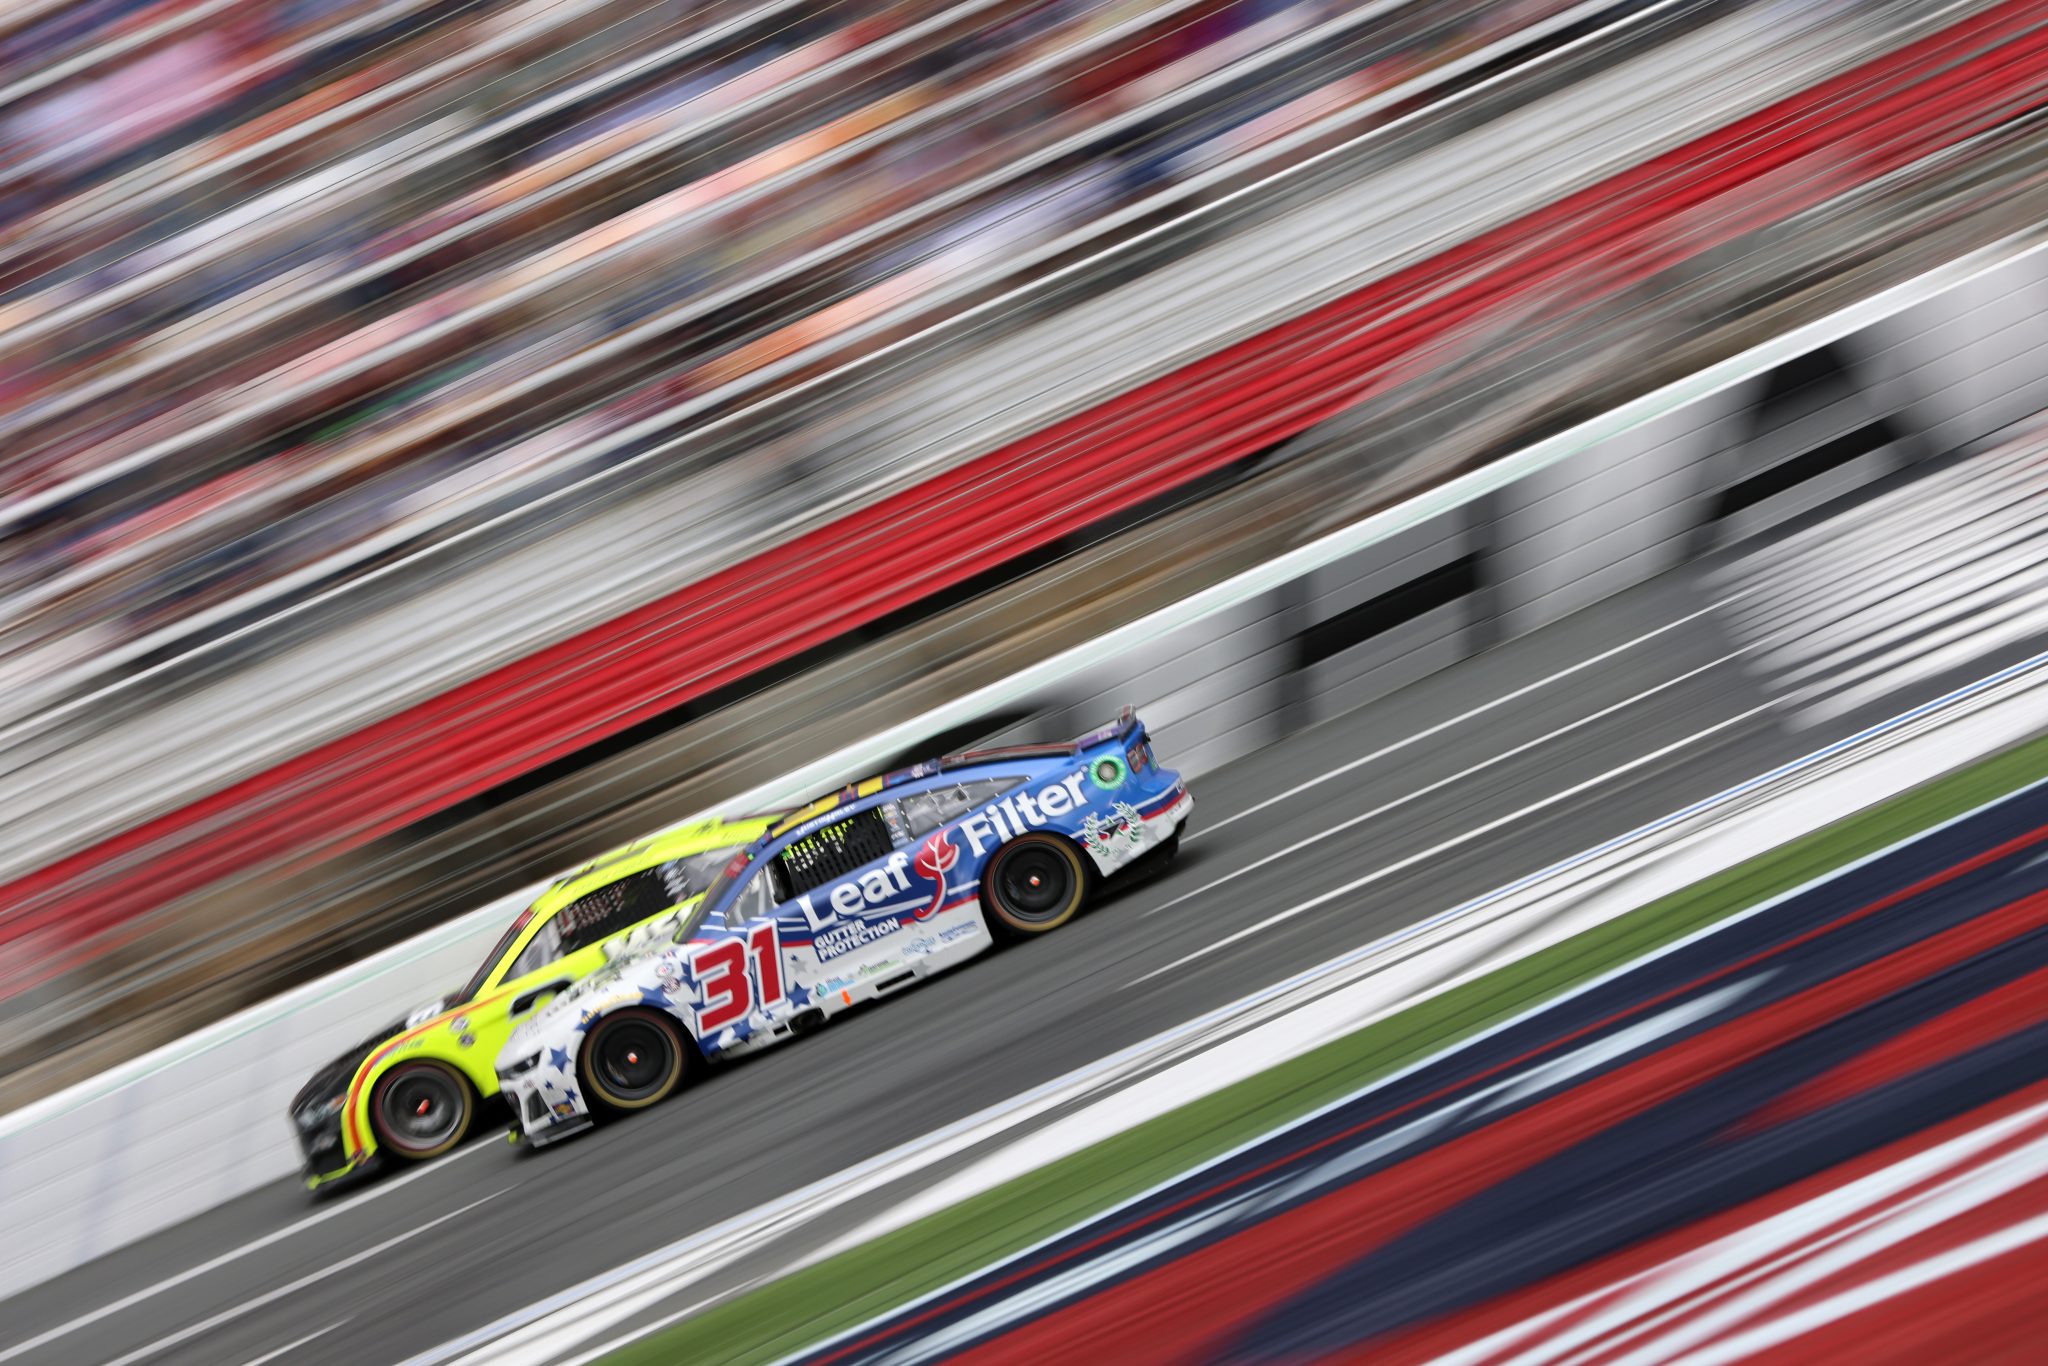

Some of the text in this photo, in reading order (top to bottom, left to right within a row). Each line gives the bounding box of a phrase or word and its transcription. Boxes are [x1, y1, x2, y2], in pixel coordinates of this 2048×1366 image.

[797, 852, 912, 933] Leaf
[959, 770, 1089, 857] Filter
[814, 918, 867, 949] GUTTER
[818, 917, 900, 962] PROTECTION
[692, 923, 785, 1035] 31
